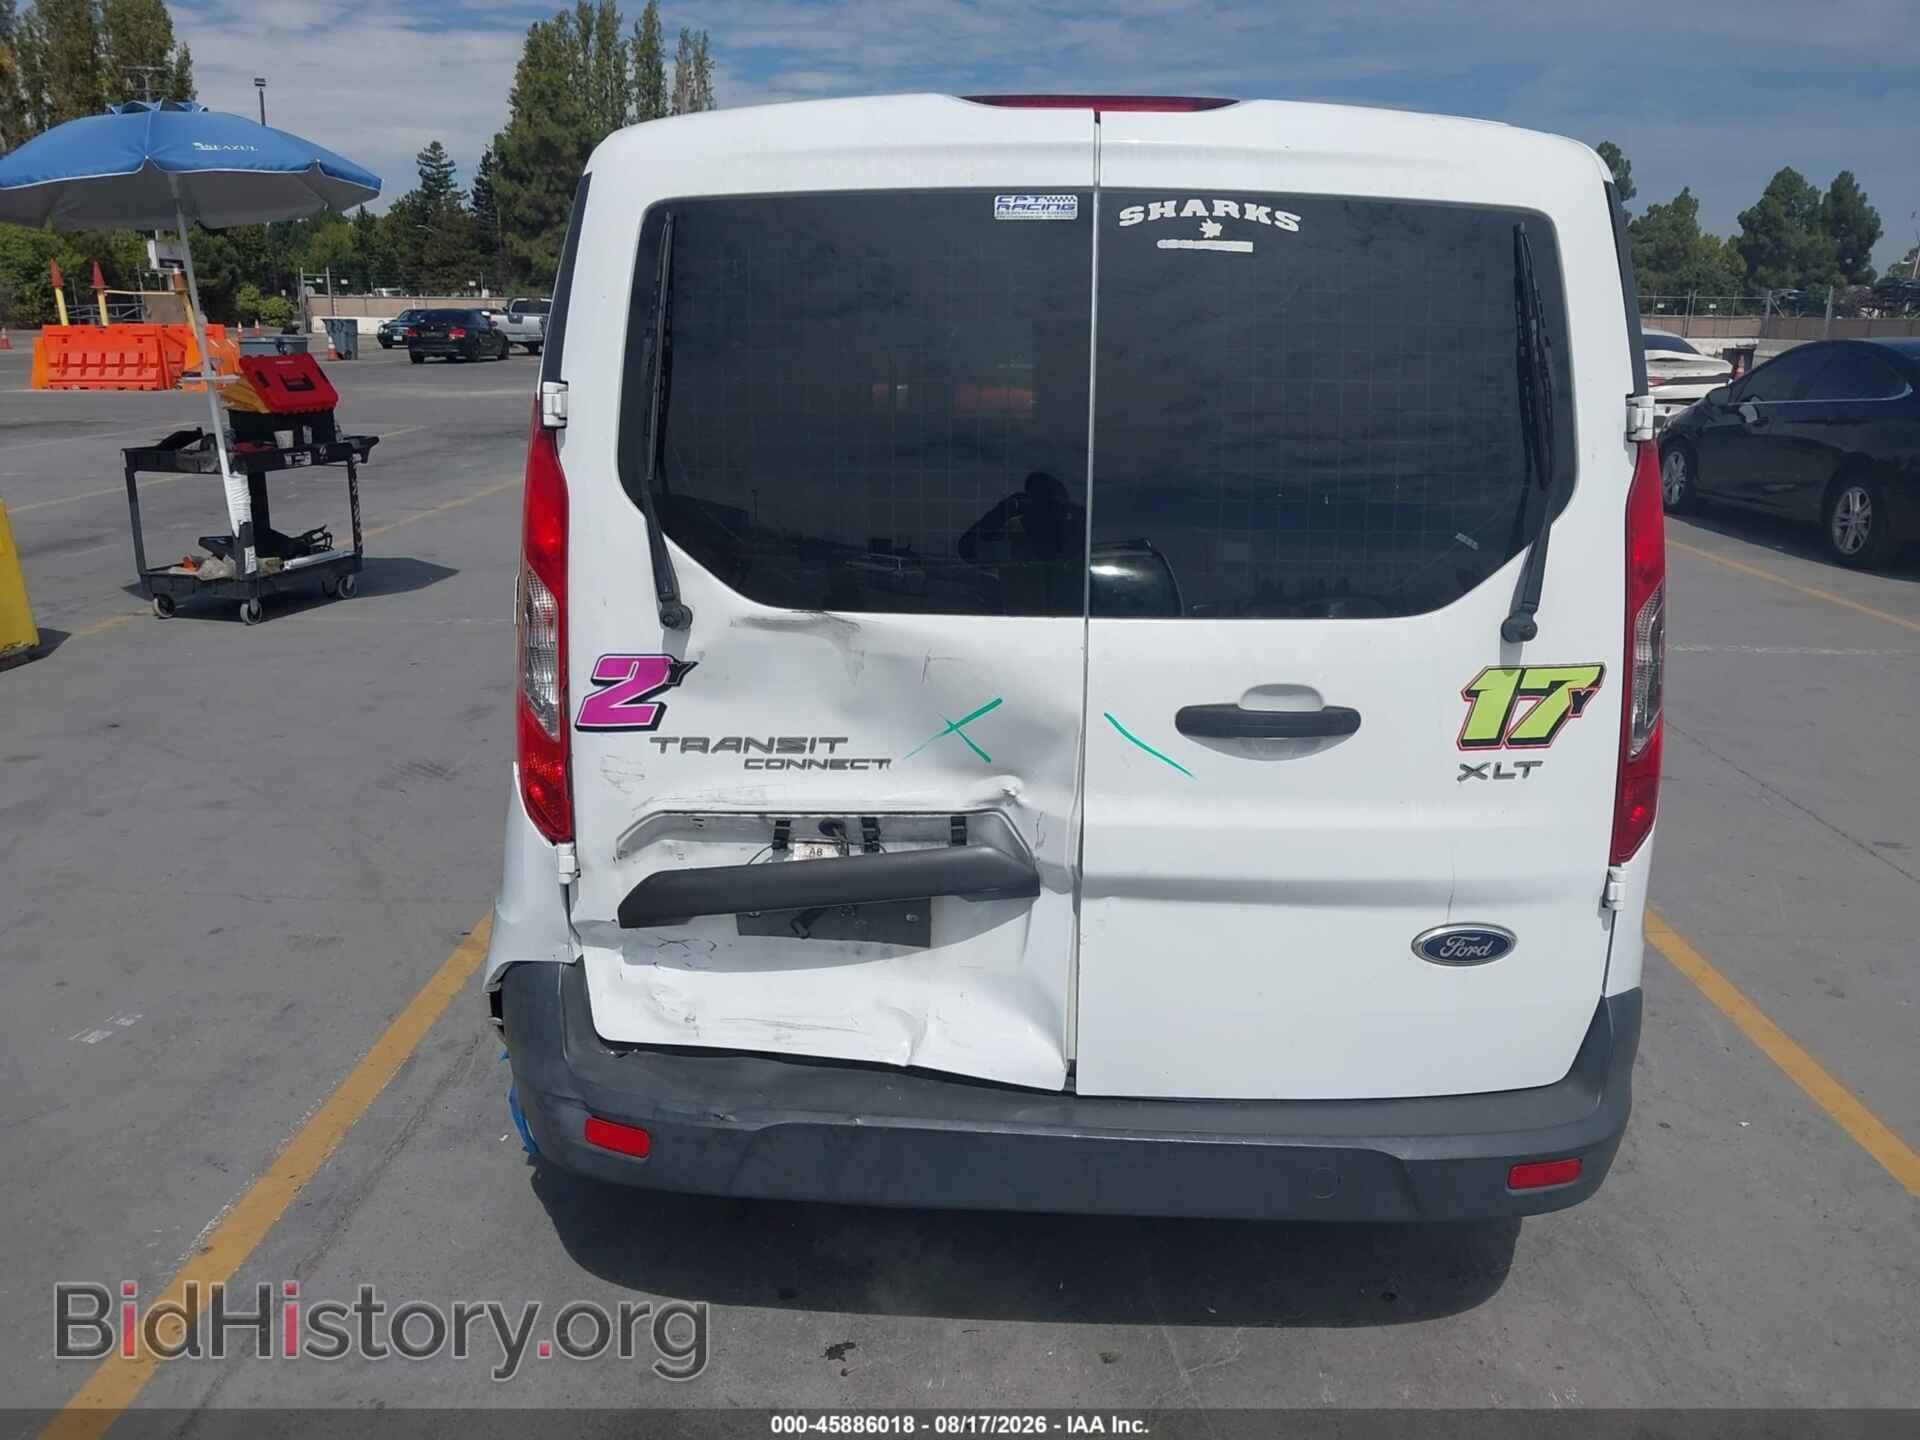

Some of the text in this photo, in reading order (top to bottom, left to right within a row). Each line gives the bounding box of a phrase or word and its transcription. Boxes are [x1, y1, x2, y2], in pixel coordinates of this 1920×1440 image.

[997, 203, 1075, 211] RACING
[1119, 199, 1301, 232] SHARKS
[650, 736, 848, 754] TRANSIT
[744, 758, 892, 770] CONNECT
[1456, 760, 1544, 783] XLT
[1439, 935, 1494, 957] Ford
